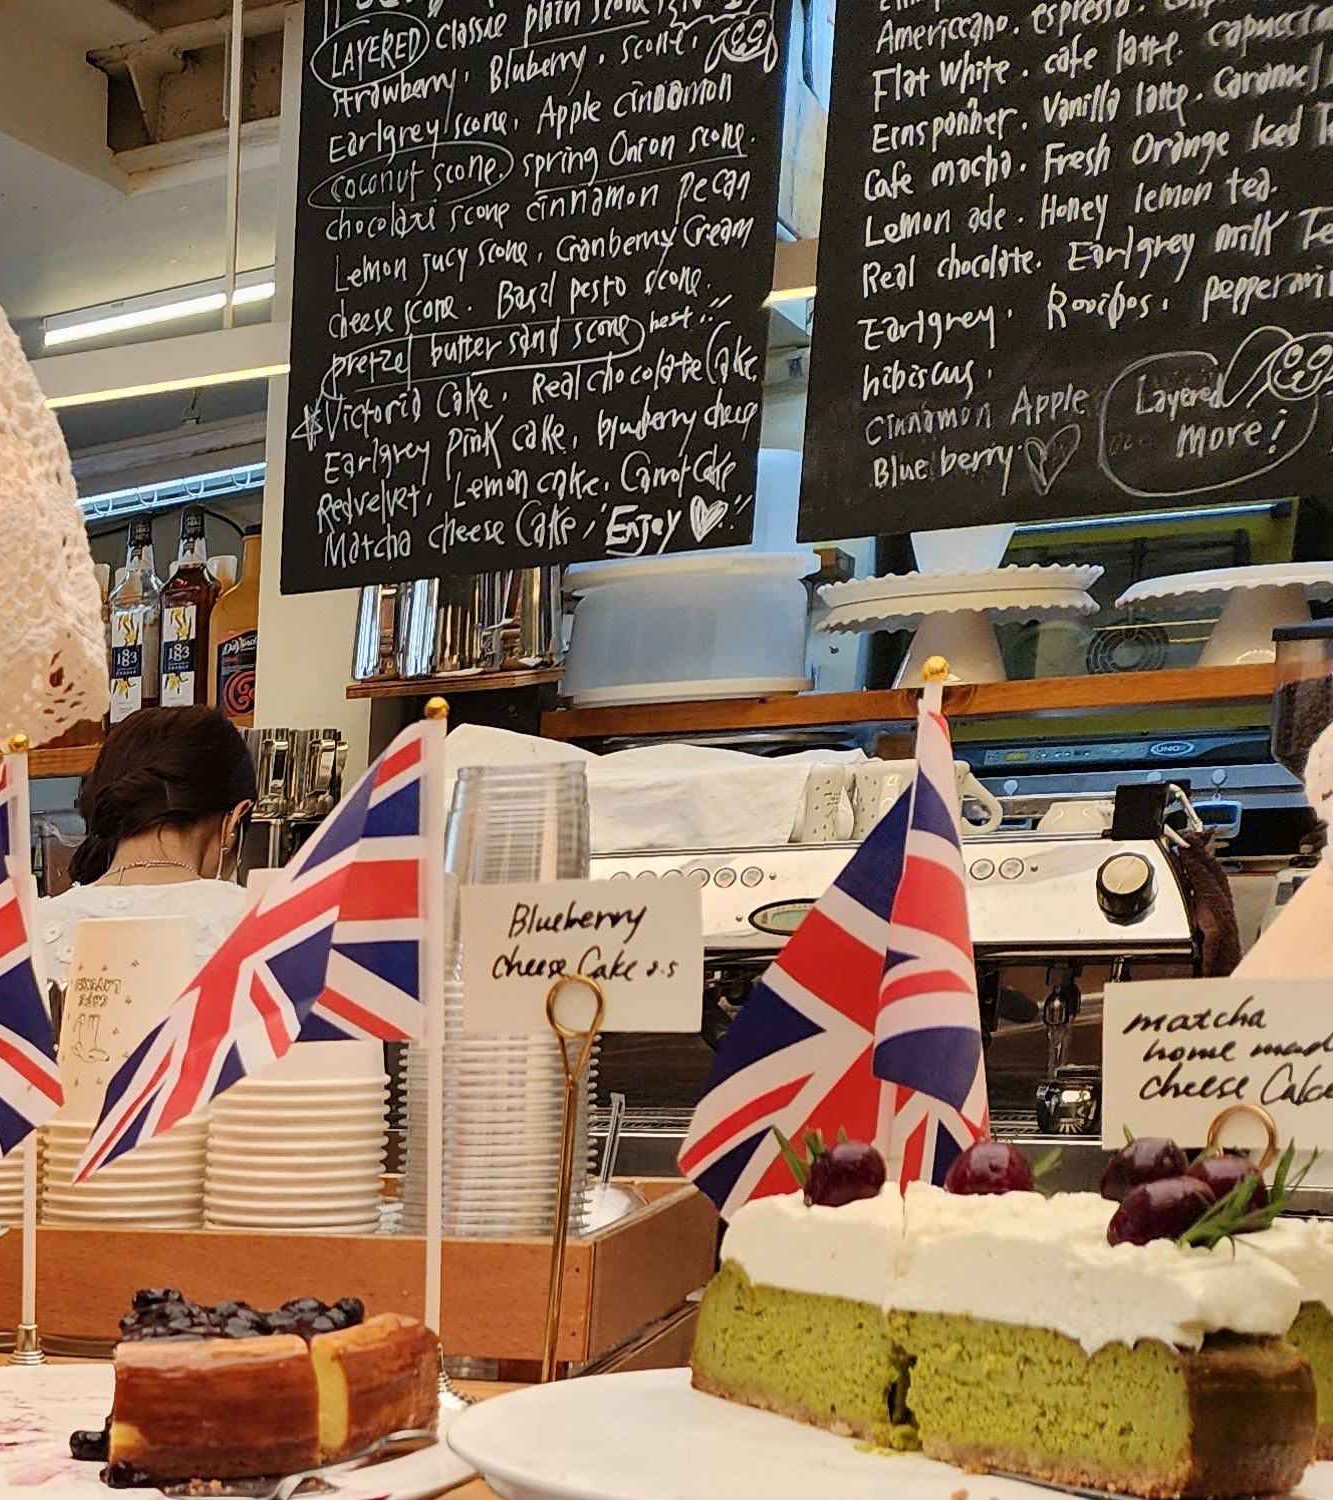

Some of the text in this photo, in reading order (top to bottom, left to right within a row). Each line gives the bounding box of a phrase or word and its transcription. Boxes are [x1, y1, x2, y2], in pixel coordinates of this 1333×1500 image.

[873, 64, 931, 112] Flat
[537, 91, 601, 140] Apple
[865, 205, 952, 249] Lemon
[1041, 194, 1109, 239] Honey
[334, 253, 407, 292] Lemon
[862, 256, 916, 299] Real
[1010, 384, 1089, 430] Apple
[454, 469, 529, 508] Lemon
[578, 946, 637, 981] Cake
